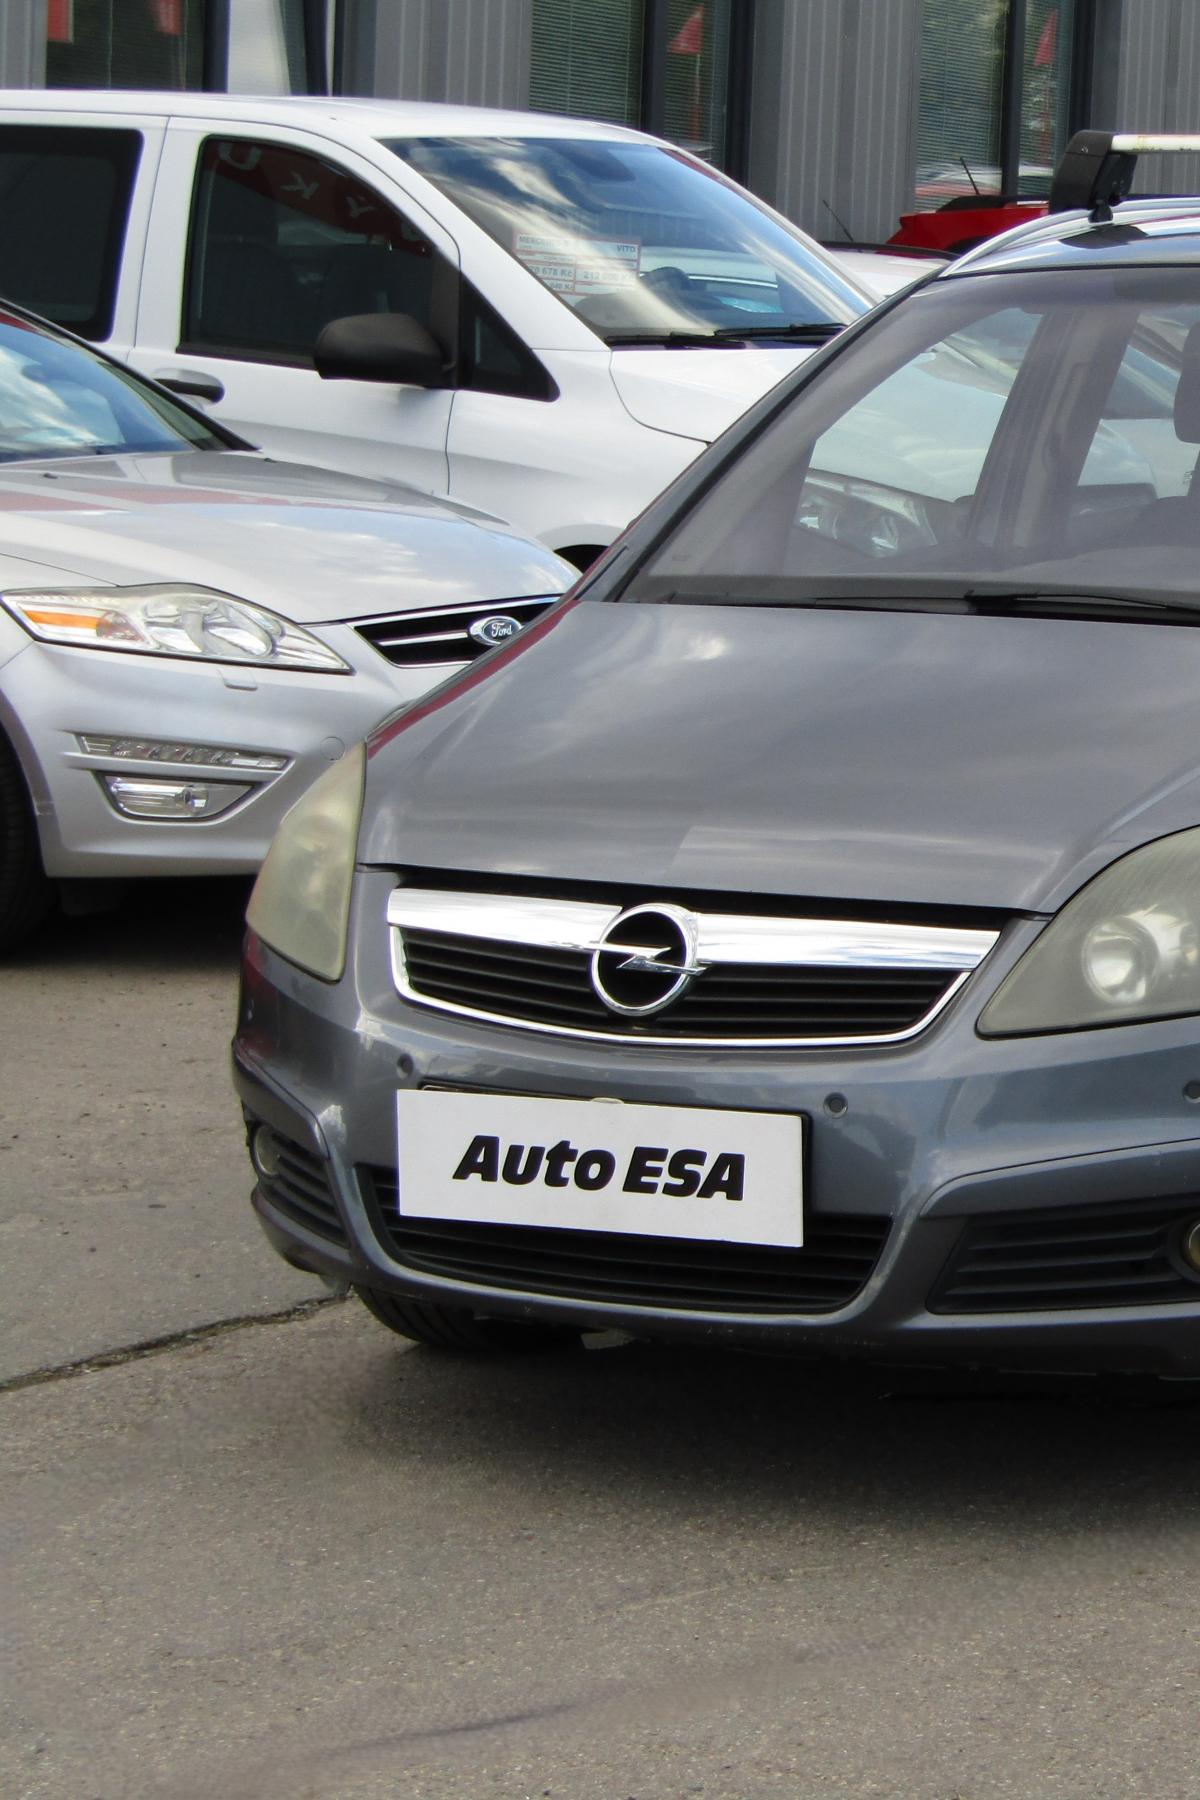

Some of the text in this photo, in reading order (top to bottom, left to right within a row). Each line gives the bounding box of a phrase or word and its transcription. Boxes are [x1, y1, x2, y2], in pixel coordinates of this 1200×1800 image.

[616, 244, 636, 253] VITO
[491, 622, 512, 637] Ford
[452, 1134, 746, 1202] Auto ESA
